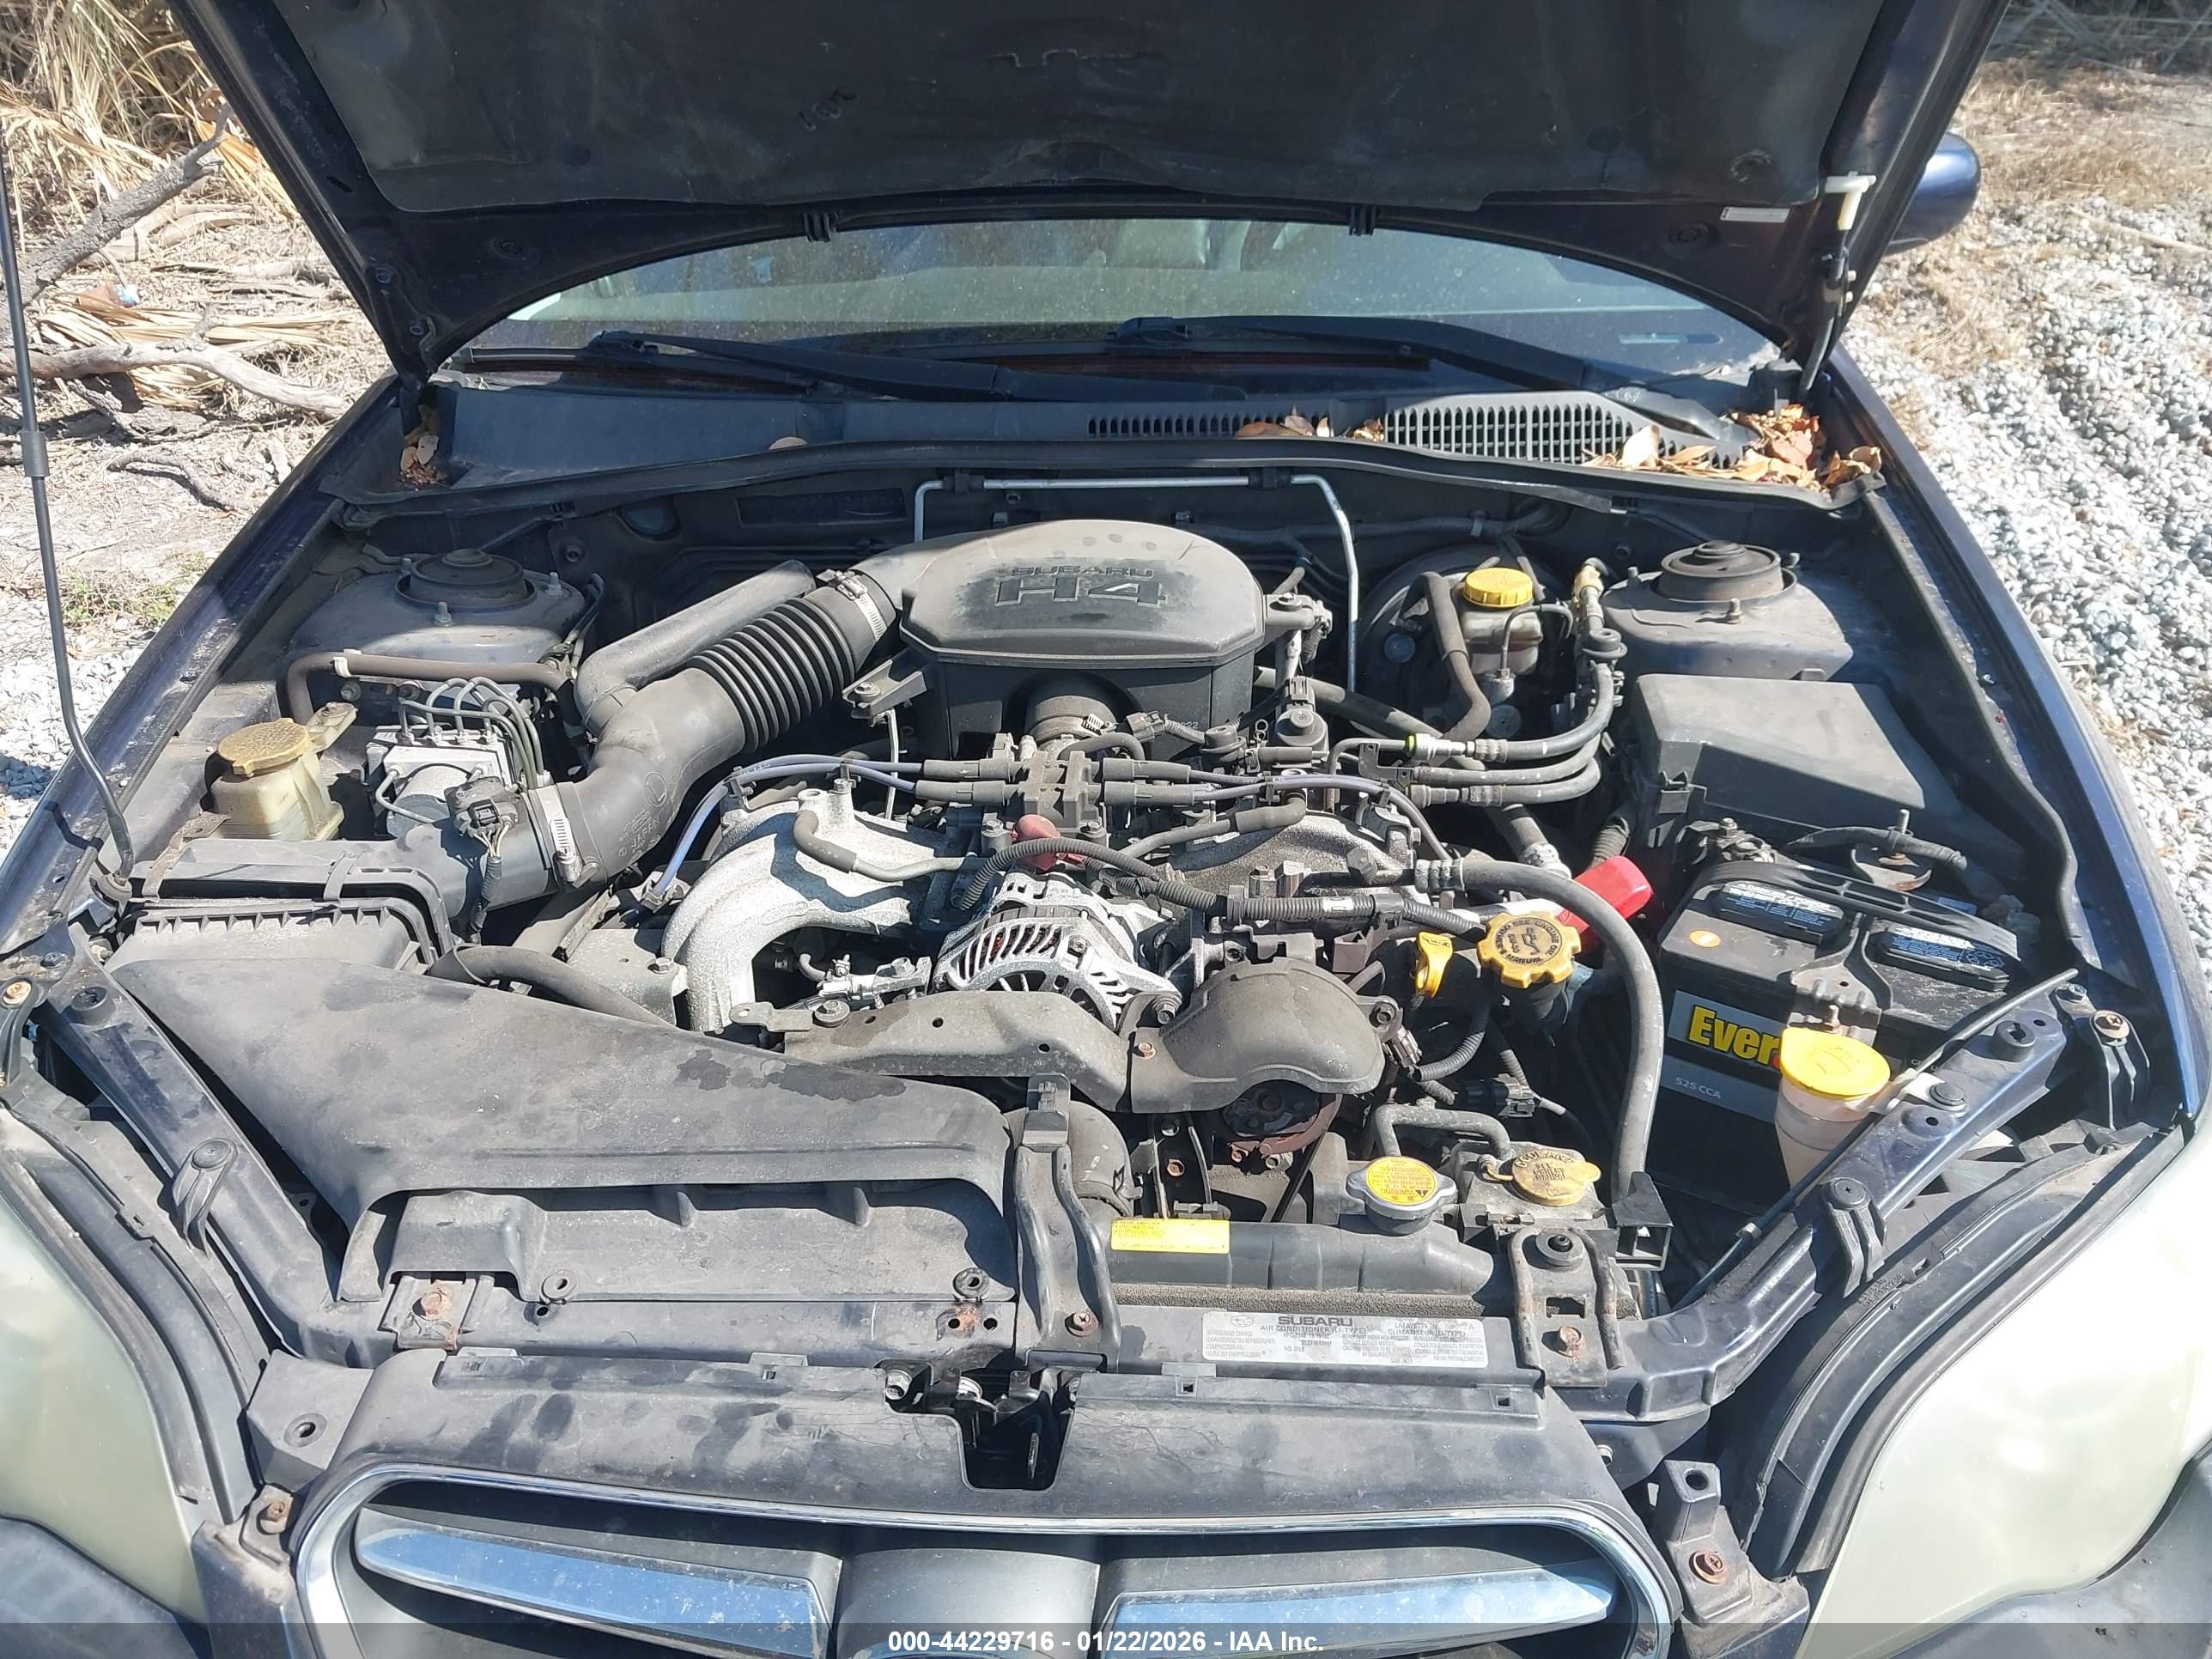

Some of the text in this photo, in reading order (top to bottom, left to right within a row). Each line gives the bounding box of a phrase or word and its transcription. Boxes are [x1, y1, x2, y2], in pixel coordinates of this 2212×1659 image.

[1012, 565, 1154, 579] SUBARU
[994, 575, 1169, 607] H4
[1675, 1077, 1721, 1099] 525 CCA
[1278, 1316, 1353, 1327] SUBARU
